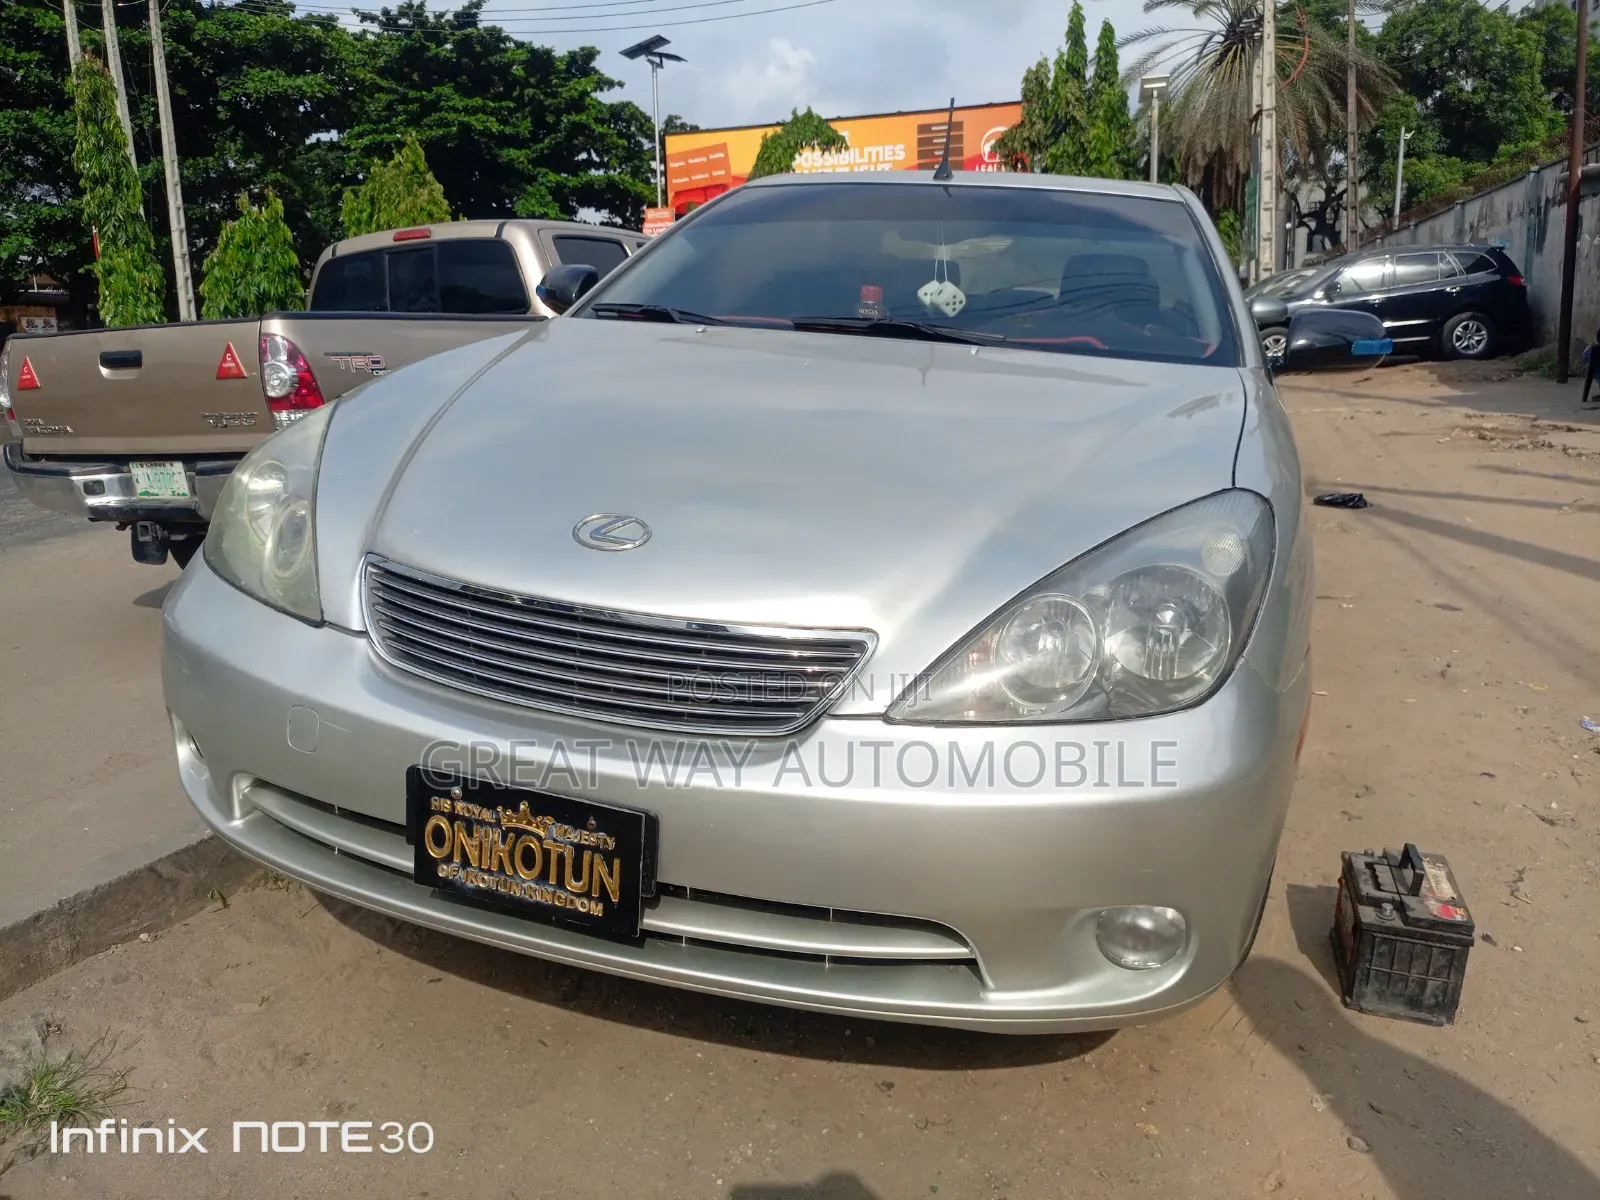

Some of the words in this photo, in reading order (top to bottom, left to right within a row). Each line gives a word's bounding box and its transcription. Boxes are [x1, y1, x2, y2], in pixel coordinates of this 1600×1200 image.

[331, 355, 386, 373] TRD
[430, 796, 452, 813] HIS
[455, 802, 496, 822] ROYAL
[554, 823, 616, 850] MAJESTY
[424, 815, 620, 902] ONIKOTUN
[437, 863, 460, 880] OF
[524, 885, 603, 916] KINGDOM
